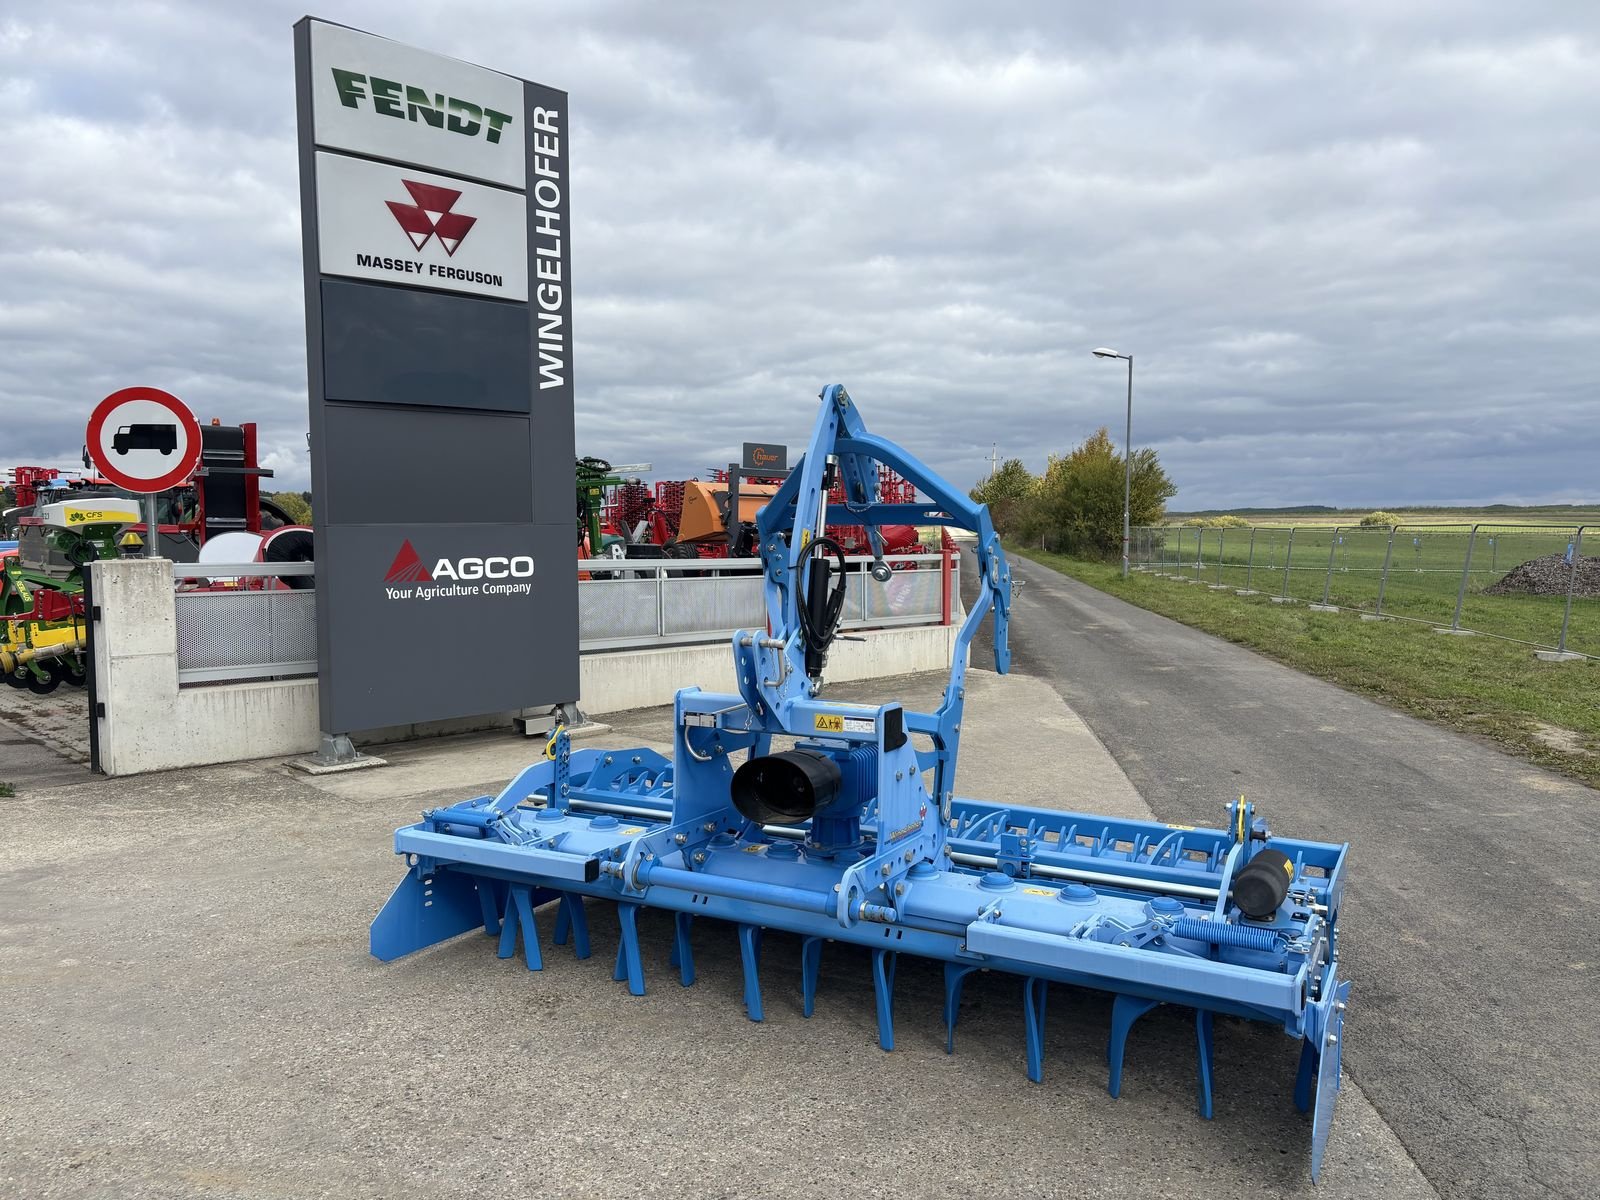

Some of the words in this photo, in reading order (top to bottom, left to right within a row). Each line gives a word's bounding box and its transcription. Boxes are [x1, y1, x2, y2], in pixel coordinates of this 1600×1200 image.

[331, 68, 513, 144] FENDT
[534, 106, 564, 390] WINGELHOFER
[356, 253, 423, 274] MASSEY
[429, 264, 503, 287] FERGUSON
[431, 556, 535, 580] AGCO
[385, 587, 413, 600] Your
[415, 584, 479, 601] Agriculture
[482, 582, 531, 596] Company
